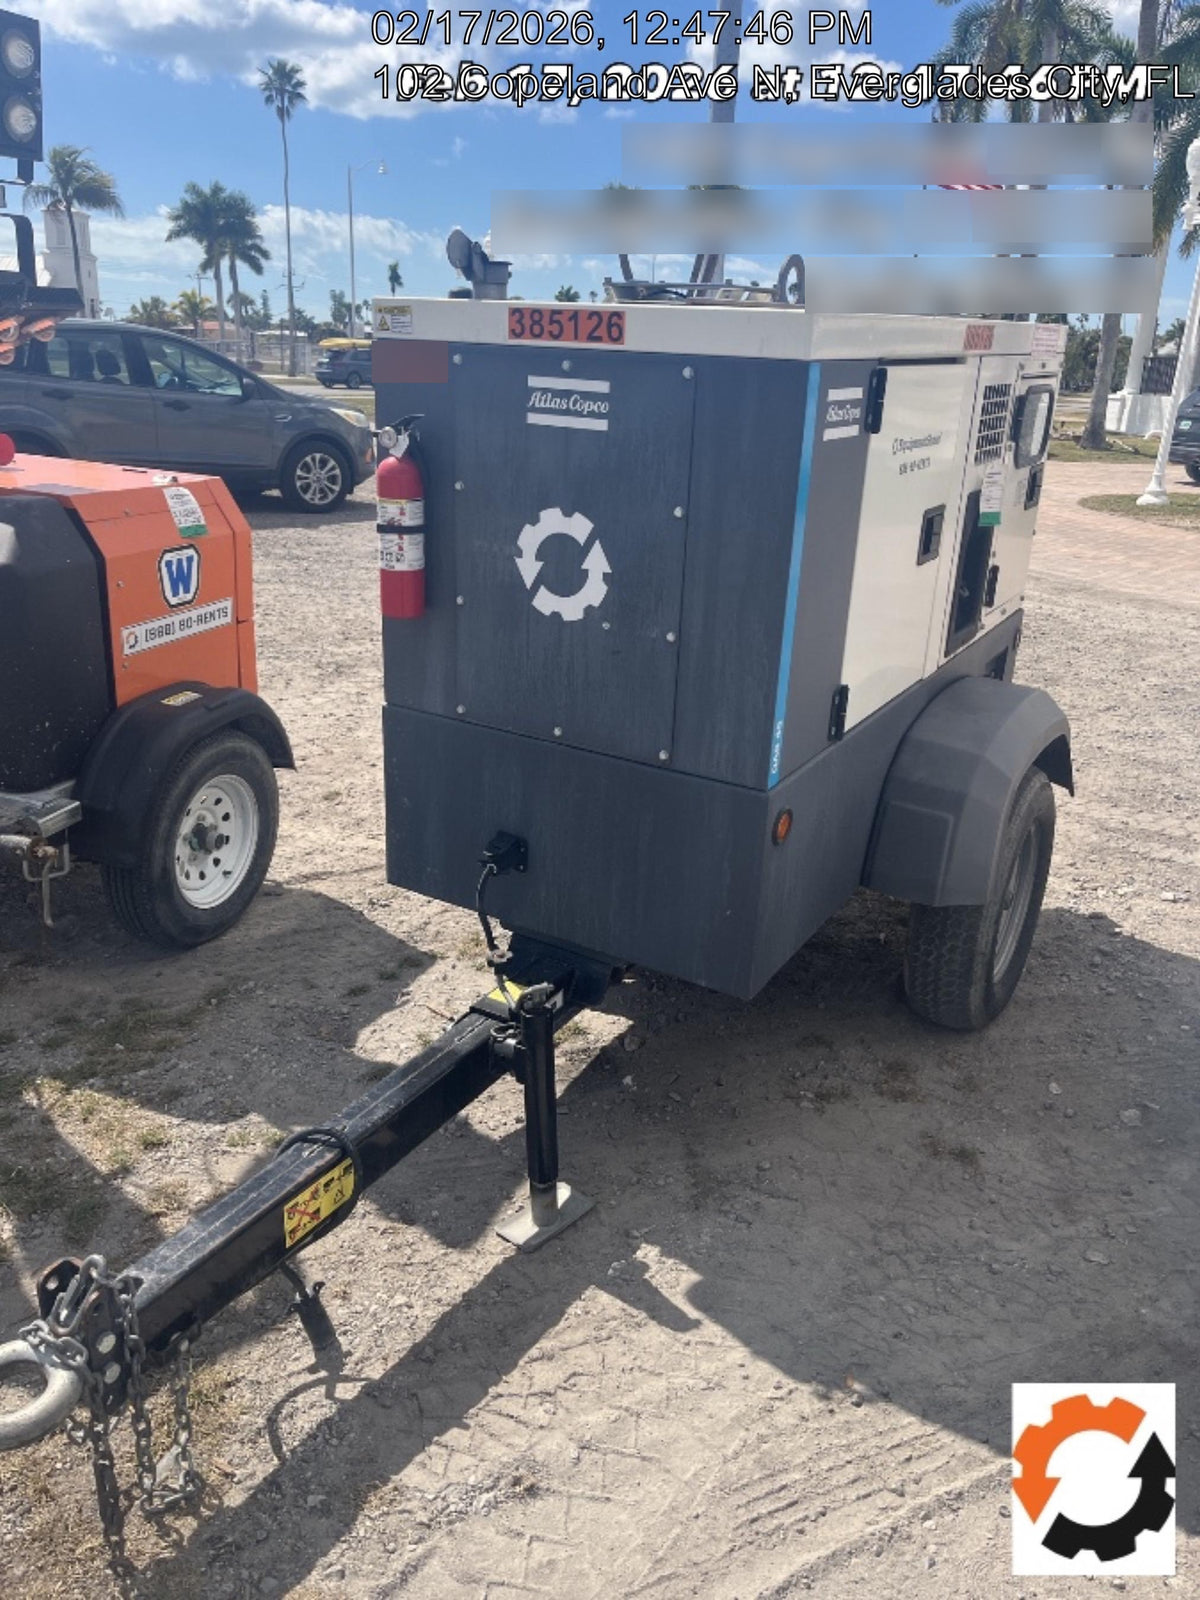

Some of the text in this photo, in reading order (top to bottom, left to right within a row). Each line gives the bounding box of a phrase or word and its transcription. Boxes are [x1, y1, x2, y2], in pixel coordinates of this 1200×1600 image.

[511, 307, 623, 342] 385126
[527, 391, 609, 415] Atlas Copco
[164, 554, 194, 598] W
